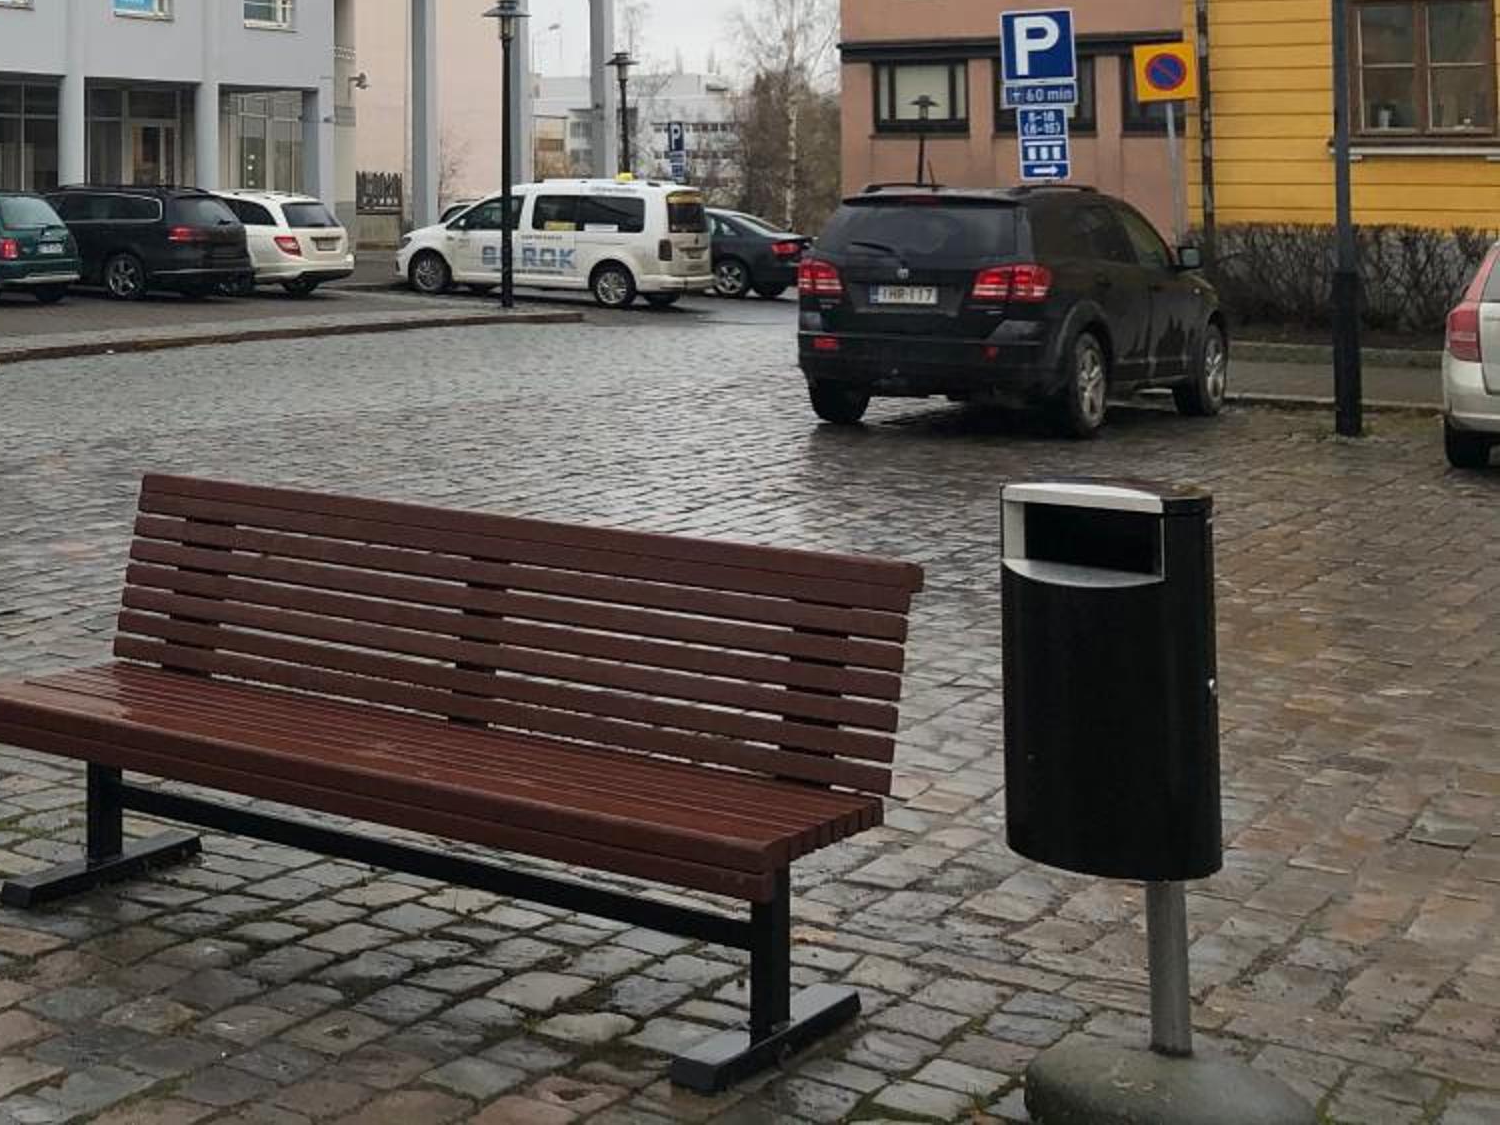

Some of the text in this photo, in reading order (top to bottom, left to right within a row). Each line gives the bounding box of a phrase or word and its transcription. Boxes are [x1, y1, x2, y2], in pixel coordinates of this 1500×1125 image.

[1013, 15, 1060, 76] P
[1026, 87, 1073, 102] 60 min
[671, 124, 681, 150] P
